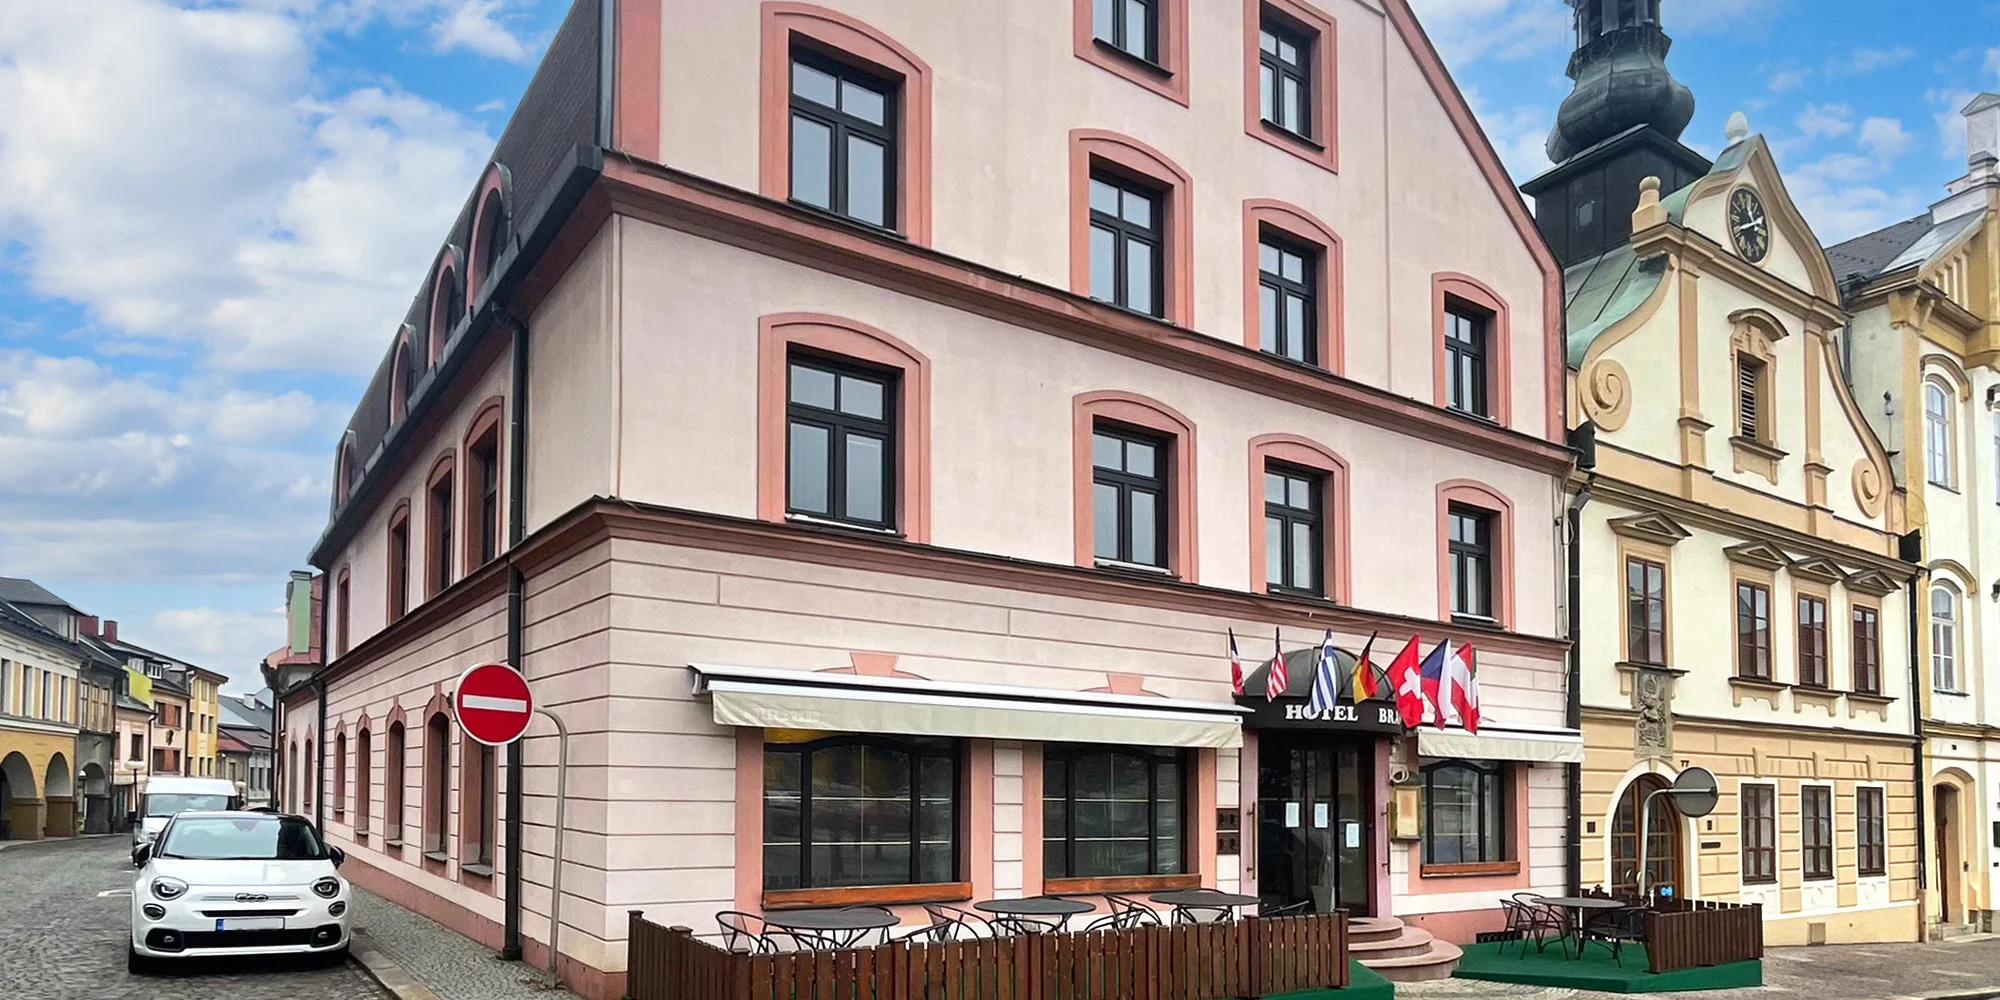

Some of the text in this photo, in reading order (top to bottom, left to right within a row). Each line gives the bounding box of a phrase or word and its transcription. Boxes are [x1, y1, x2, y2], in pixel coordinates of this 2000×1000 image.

[1285, 704, 1401, 725] HOTEL BRA
[1680, 759, 1690, 768] 77
